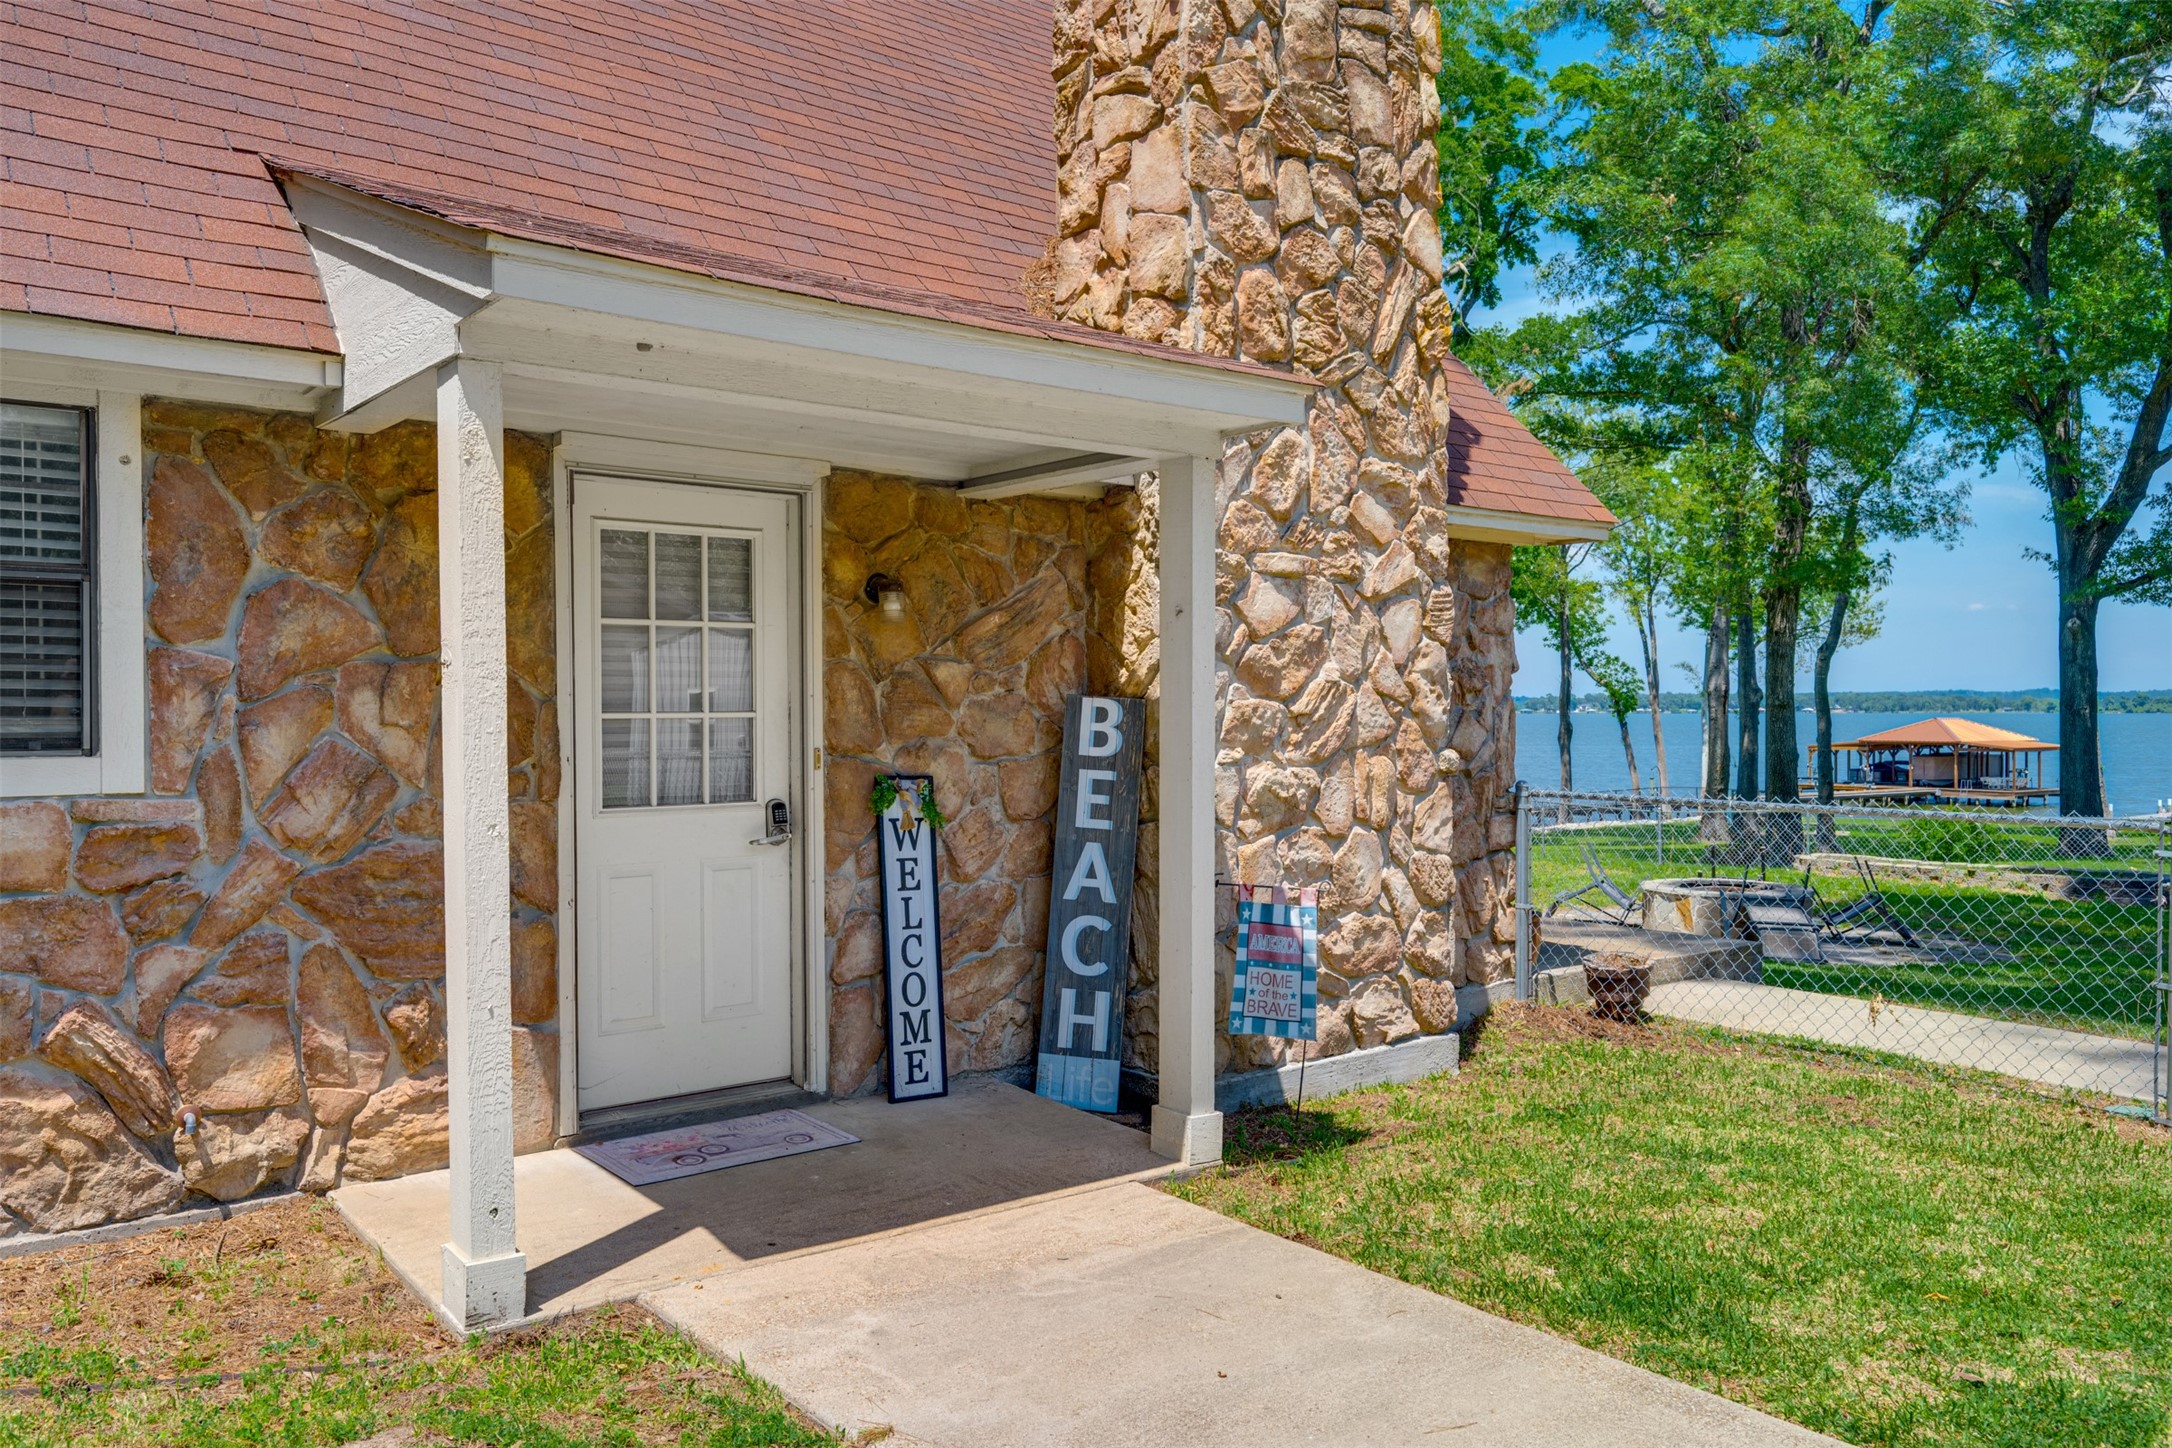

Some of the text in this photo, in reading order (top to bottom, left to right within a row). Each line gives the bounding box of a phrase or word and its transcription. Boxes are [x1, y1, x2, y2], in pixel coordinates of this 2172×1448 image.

[1058, 697, 1123, 1052] BEACH
[889, 818, 932, 1086] WELCOME
[1250, 934, 1300, 954] AMERICA
[1250, 971, 1293, 989] HOME
[1258, 989, 1288, 1000] of the
[1247, 999, 1297, 1018] BRAVE
[1046, 1063, 1114, 1105] Life
